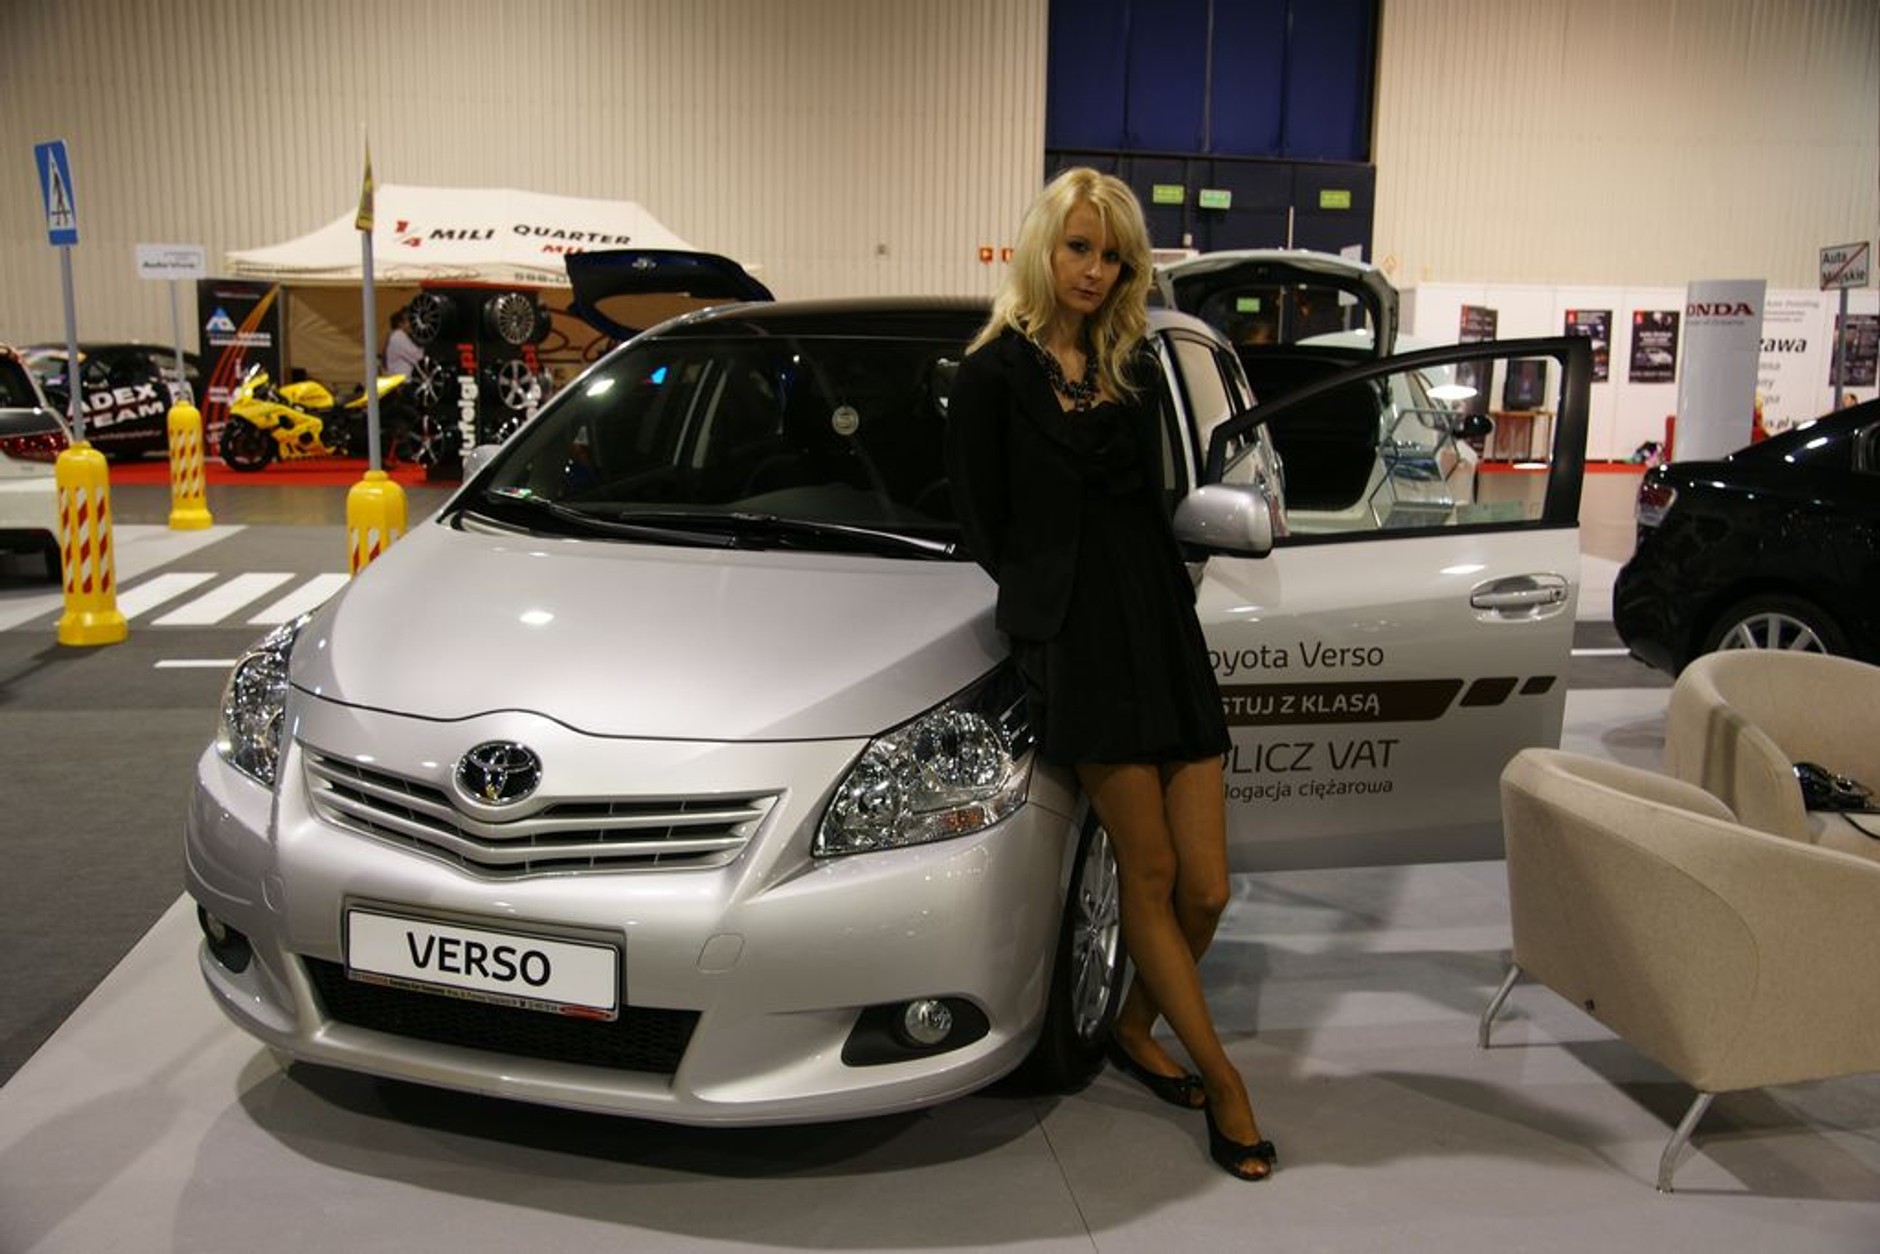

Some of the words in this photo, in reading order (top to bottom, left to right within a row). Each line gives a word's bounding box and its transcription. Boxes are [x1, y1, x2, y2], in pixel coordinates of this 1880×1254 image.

[428, 228, 496, 240] MILI
[513, 224, 631, 246] QUARTER
[1299, 641, 1385, 668] Verso
[1279, 695, 1296, 714] Z
[1301, 693, 1381, 716] KLASĄ
[1222, 740, 1314, 774] LICZ
[1327, 739, 1399, 771] VAT
[1225, 781, 1292, 803] logacja
[1299, 779, 1394, 801] ciężarowa
[406, 931, 552, 987] VERSO
